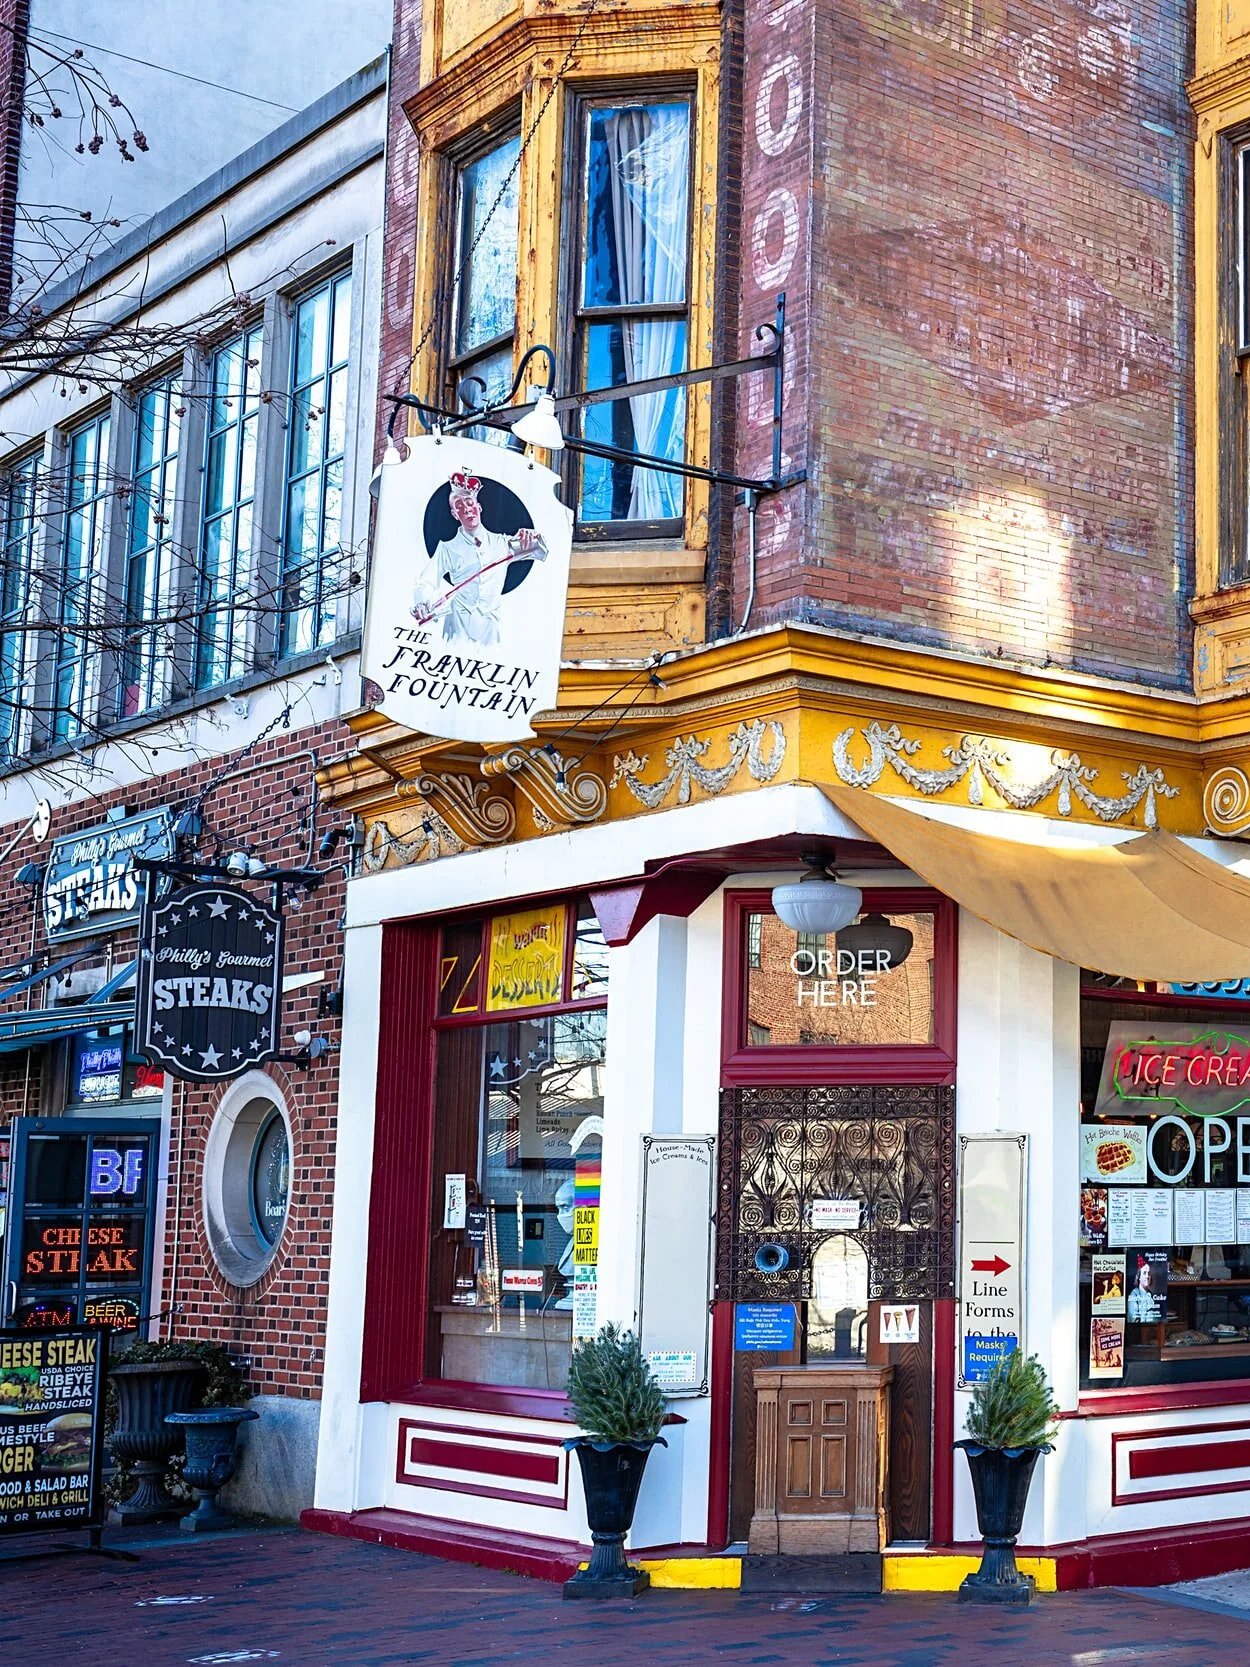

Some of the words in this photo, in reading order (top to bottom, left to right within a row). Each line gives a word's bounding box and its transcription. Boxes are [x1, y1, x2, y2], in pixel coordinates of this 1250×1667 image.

[394, 626, 432, 645] THE
[382, 645, 540, 693] FRANKLIN
[386, 673, 537, 719] FOUNTAIN
[70, 837, 107, 868] Philly's
[106, 823, 148, 860] Gourmet
[46, 864, 141, 929] STEAKS
[156, 947, 212, 971] Philly's
[215, 950, 274, 969] Gourmet
[790, 949, 893, 976] ORDER
[491, 952, 560, 1002] DESSERTS
[154, 977, 273, 1015] STEAKS
[797, 979, 878, 1007] HERE
[1133, 1054, 1180, 1086] ICE
[649, 1157, 660, 1165] Ice
[576, 1211, 595, 1224] BLACK
[972, 1281, 1008, 1297] Line
[85, 1305, 126, 1317] BEER
[965, 1301, 1014, 1318] Forms
[24, 1311, 71, 1327] ATM
[99, 1316, 137, 1328] WINE
[0, 1342, 42, 1368] EESE
[47, 1338, 96, 1366] STEAK
[975, 1340, 1005, 1350] Masks
[65, 1365, 94, 1373] CHOICE
[40, 1372, 93, 1387] RIBEYE
[44, 1385, 92, 1399] STEAK
[25, 1399, 92, 1411] HANDSLICED
[18, 1424, 46, 1434] BEEF
[0, 1446, 34, 1474] GER
[24, 1480, 31, 1493] &
[34, 1477, 67, 1492] SALAD
[69, 1475, 88, 1489] BAR
[27, 1493, 49, 1507] DELI
[51, 1492, 58, 1505] &
[61, 1489, 89, 1504] GRILL
[14, 1513, 29, 1521] OR
[35, 1509, 61, 1519] TAKE
[64, 1507, 85, 1516] OUT
